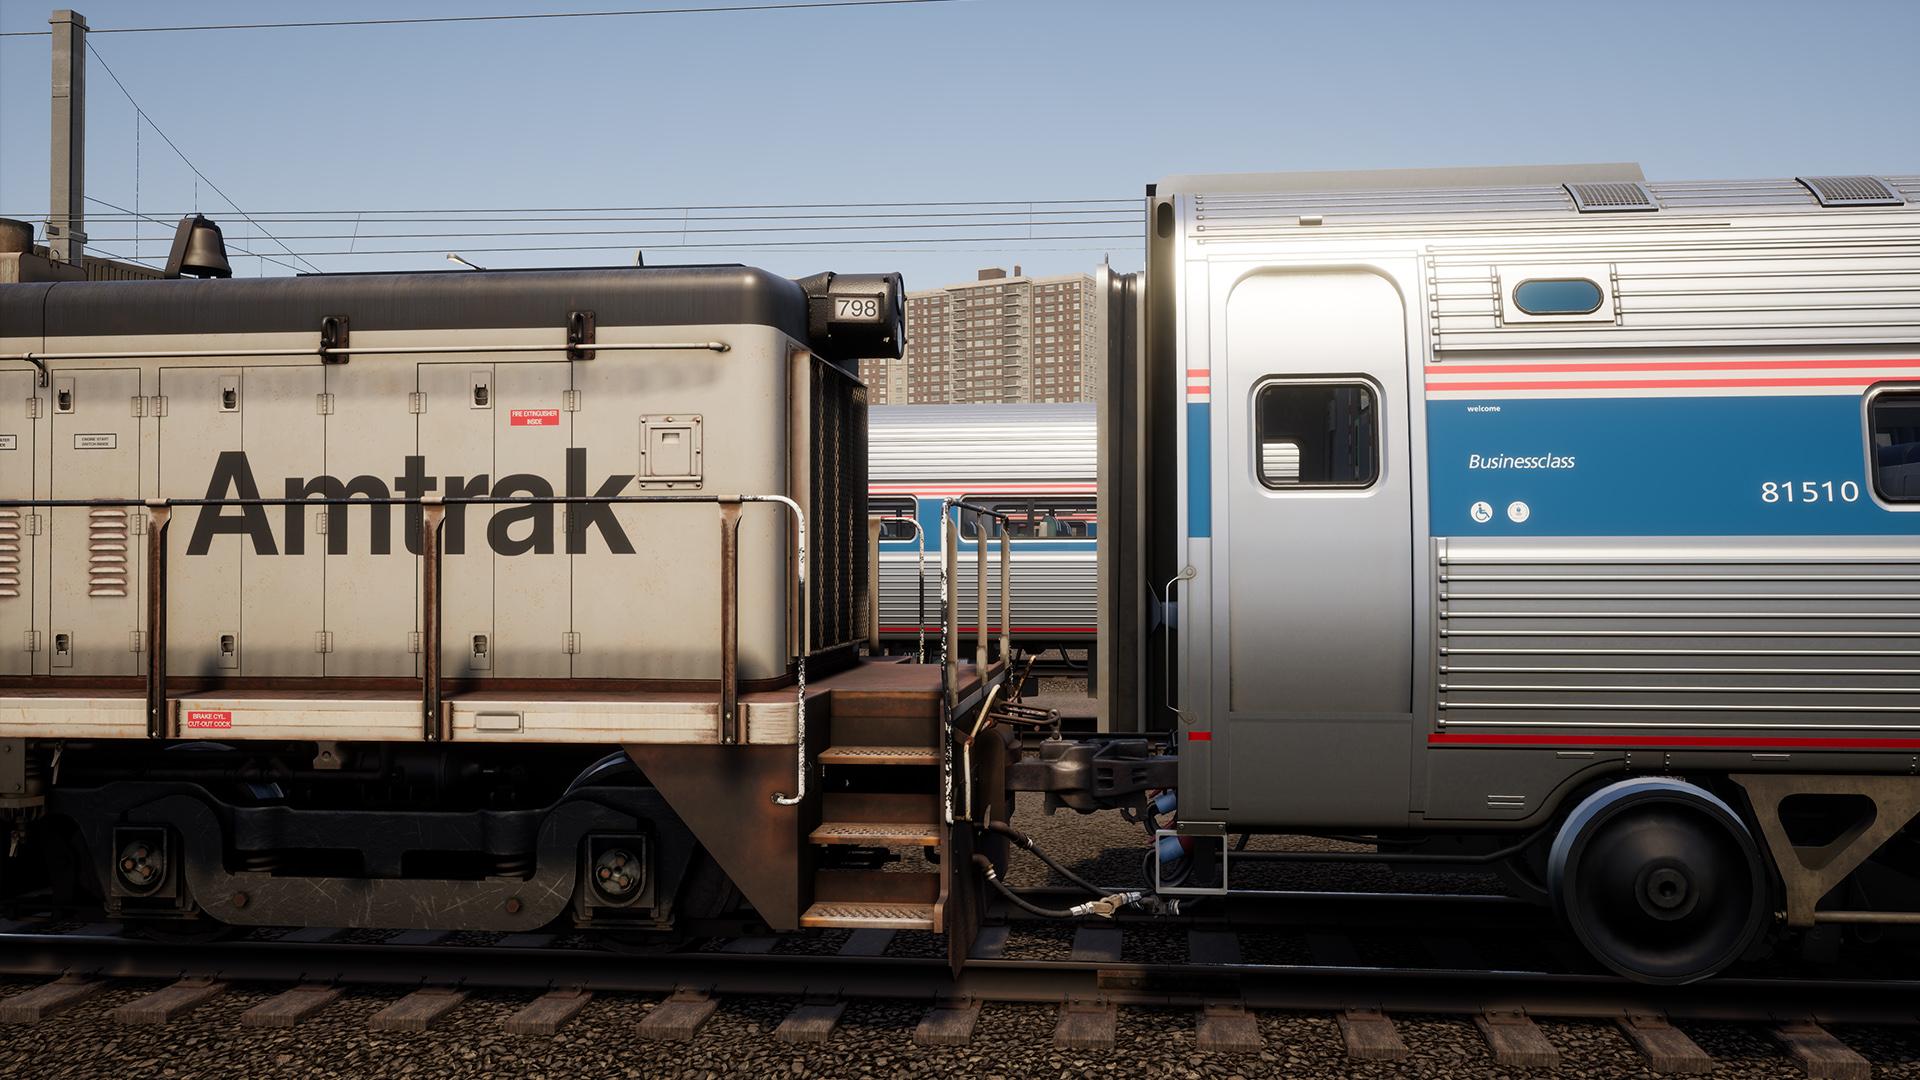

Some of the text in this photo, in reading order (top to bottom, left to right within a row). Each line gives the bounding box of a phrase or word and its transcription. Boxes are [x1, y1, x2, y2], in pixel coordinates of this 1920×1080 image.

[838, 300, 877, 317] 798
[1467, 405, 1501, 413] welcome
[1469, 453, 1576, 469] Businessclass
[1761, 481, 1859, 503] 81510
[186, 448, 637, 556] Amtrak
[188, 720, 231, 728] CUT-OUT COCK
